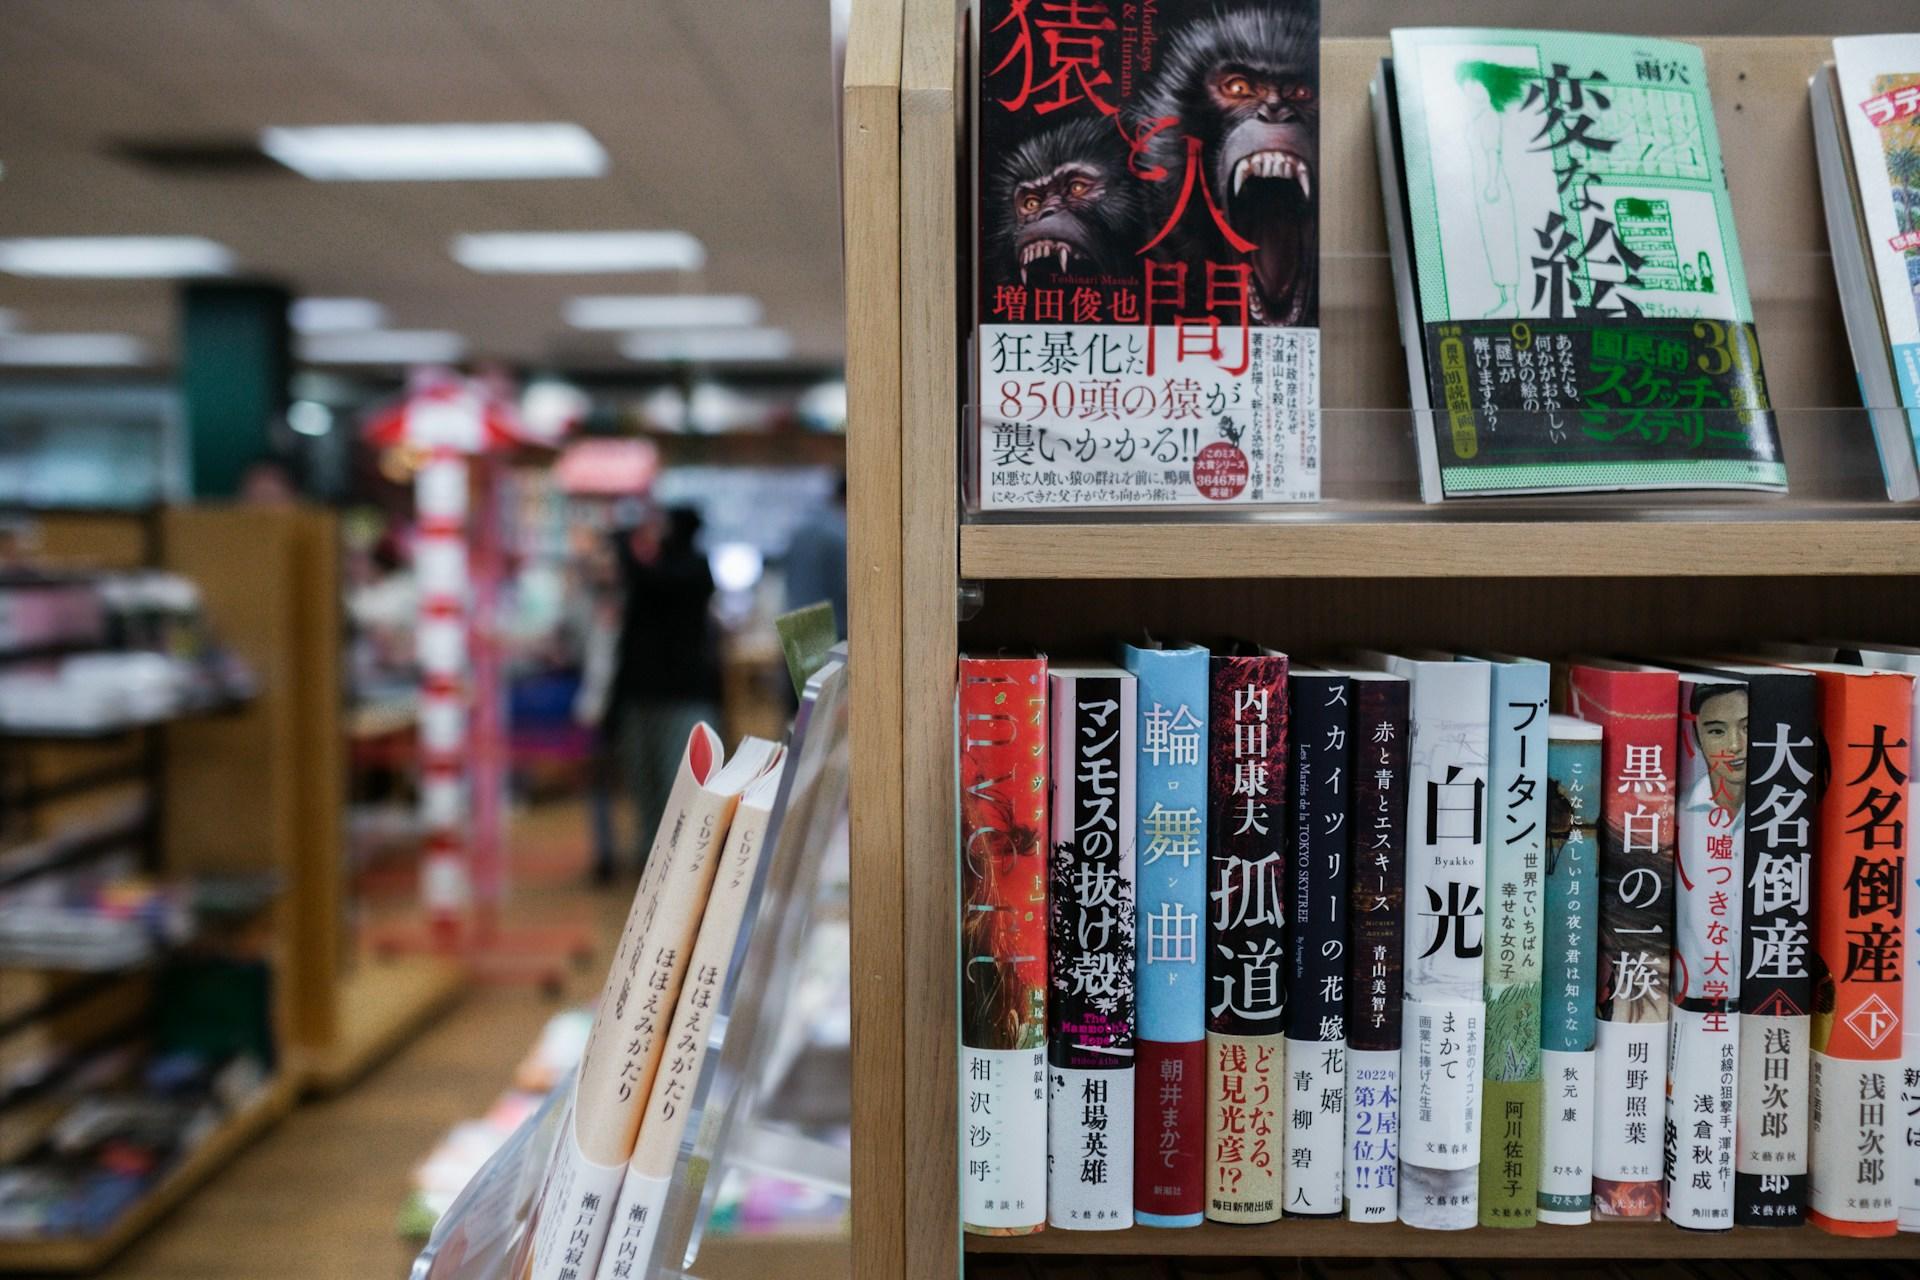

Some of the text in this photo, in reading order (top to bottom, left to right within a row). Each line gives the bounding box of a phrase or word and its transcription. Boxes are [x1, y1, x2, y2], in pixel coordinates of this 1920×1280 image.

[1121, 26, 1138, 97] Humans
[1635, 60, 1690, 85] 雨穴
[1520, 63, 1647, 319] 変な絵
[992, 286, 1141, 323] 増田俊也
[991, 331, 1145, 376] 狂暴化した
[1473, 336, 1499, 433] 解けますか?
[1510, 323, 1541, 414] 9枚の絵の
[1535, 334, 1568, 444] 何かがおかしい
[1556, 333, 1580, 403] あなたも、
[999, 377, 1242, 423] 850頭の猿が
[1582, 399, 1750, 449] ミステリー
[991, 421, 1200, 467] 襲いかかる!!
[1231, 684, 1270, 836] 内田康夫
[1299, 743, 1311, 760] Les
[1298, 812, 1310, 822] la
[1299, 798, 1311, 810] de
[1370, 721, 1396, 913] 赤と青とエスキース
[1074, 698, 1121, 997] マンモスの抜け殻
[1298, 823, 1310, 868] TOKYO
[1417, 765, 1486, 960] 白光
[1434, 856, 1476, 868] Byakko
[1609, 743, 1668, 1001] 黒白の一族
[1746, 722, 1815, 980] 大名倒産
[1841, 723, 1908, 984] 大名倒産
[1297, 869, 1309, 924] SKYTREE
[1500, 881, 1518, 980] 幸せな女の子
[1564, 763, 1585, 1047] こんなに美しい月の夜を君は知らない
[1702, 751, 1735, 1033] 六人の嘘つきな大学生
[1210, 851, 1286, 1021] 孤道
[618, 946, 677, 1104] ほほえみがたり
[1370, 944, 1388, 1029] 青山美智子
[1859, 1006, 1887, 1040] 下
[662, 964, 719, 1122] ほほえみがたり
[1356, 1069, 1397, 1082] 2022年
[1418, 1015, 1433, 1123] 画業に捧げた生涯
[1439, 1011, 1461, 1080] まかて
[969, 1056, 992, 1183] 相沢沙呼
[1159, 1059, 1184, 1169] 朝井まかて
[1215, 1043, 1248, 1194] 浅見光彦!?
[1248, 1044, 1275, 1178] どうなる、
[1624, 1041, 1650, 1145] 明野照葉
[1717, 1043, 1735, 1193] 伏線の狙撃手、渾身作!
[1760, 1028, 1791, 1140] 浅田次郎
[1081, 1078, 1109, 1186] 相場英雄
[1291, 1069, 1314, 1207] 青柳碧人
[1353, 1085, 1376, 1190] 第2位!!
[1375, 1085, 1398, 1189] 本屋大賞
[1425, 1142, 1469, 1154] 文藝春秋
[1503, 1100, 1525, 1198] 阿川佐和子
[1691, 1094, 1715, 1191] 浅倉秋成
[1750, 1151, 1797, 1163] 文藝春秋
[1856, 1072, 1887, 1186] 浅田次郎
[984, 1199, 1026, 1210] 講談社
[1153, 1185, 1182, 1196] 新潮社
[1212, 1199, 1275, 1212] 毎日新聞出版
[1424, 1195, 1470, 1206] 文藝春秋
[1551, 1195, 1583, 1206] 幻冬舎
[1552, 1166, 1584, 1176] 幻冬舎
[1617, 1199, 1648, 1210] 光文社
[1619, 1165, 1650, 1176] 光文社
[1847, 1197, 1894, 1210] 文藝春秋
[1070, 1209, 1120, 1220] 文藝春秋
[1364, 1206, 1386, 1215] PHP
[1491, 1207, 1533, 1218] 文藝春秋
[1691, 1207, 1729, 1219] 角川書店
[1750, 1204, 1799, 1217] 文藝春秋
